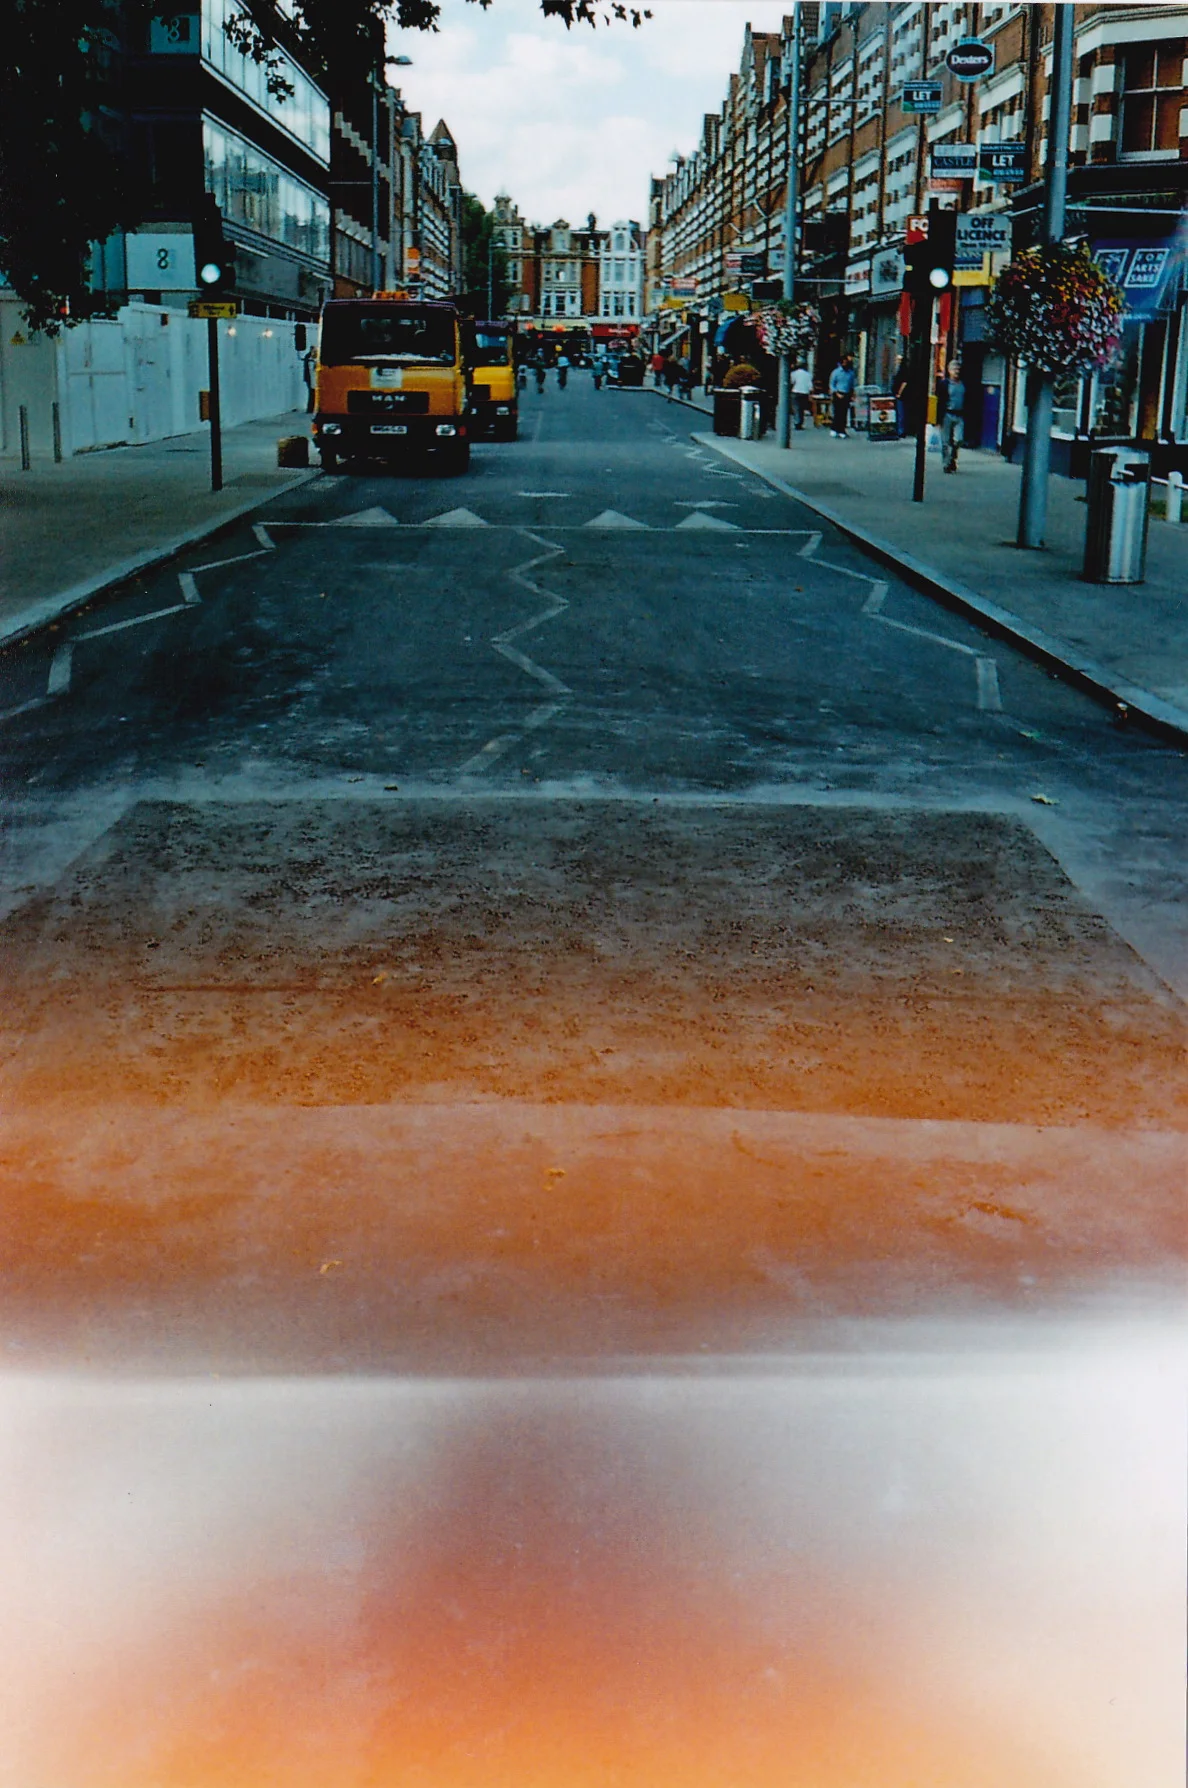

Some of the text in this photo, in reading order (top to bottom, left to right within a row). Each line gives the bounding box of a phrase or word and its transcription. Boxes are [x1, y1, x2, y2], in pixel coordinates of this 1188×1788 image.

[951, 54, 989, 64] Dexters
[912, 91, 932, 101] LET
[992, 154, 1015, 167] LET
[970, 217, 994, 229] OFF
[957, 229, 1006, 241] LICENCE
[157, 248, 169, 270] 8
[1134, 264, 1160, 273] ARTS
